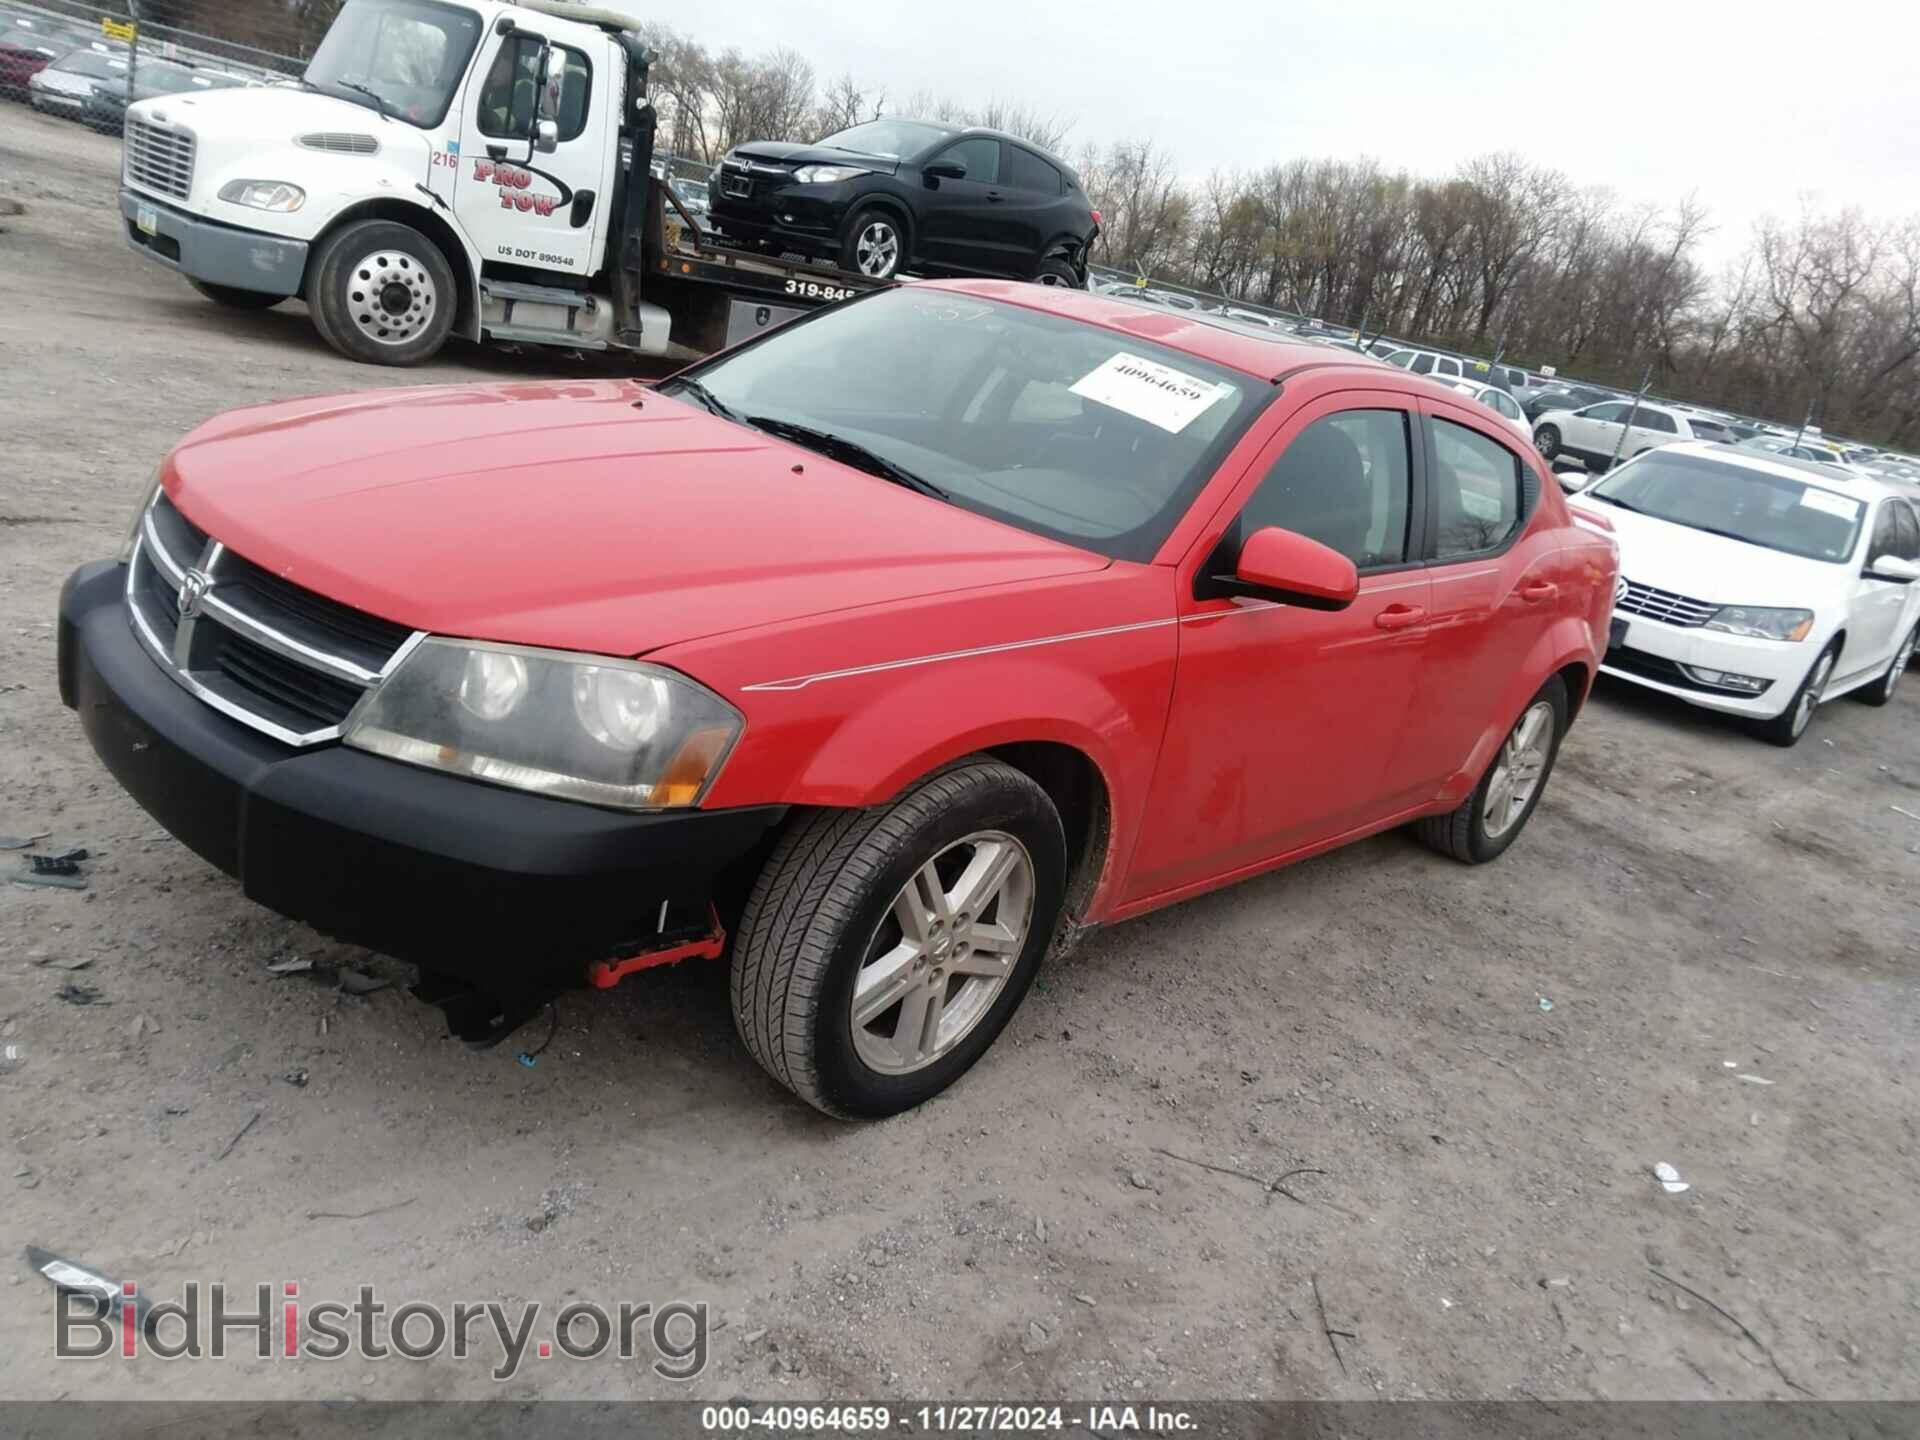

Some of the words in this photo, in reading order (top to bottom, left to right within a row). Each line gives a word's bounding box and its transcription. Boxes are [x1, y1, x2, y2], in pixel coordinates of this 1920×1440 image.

[432, 151, 458, 169] 216
[473, 160, 532, 189] PRO
[499, 187, 559, 216] TOW
[498, 245, 512, 256] US
[515, 248, 536, 260] DOT
[538, 253, 574, 266] 890548
[1114, 365, 1200, 400] 40964659
